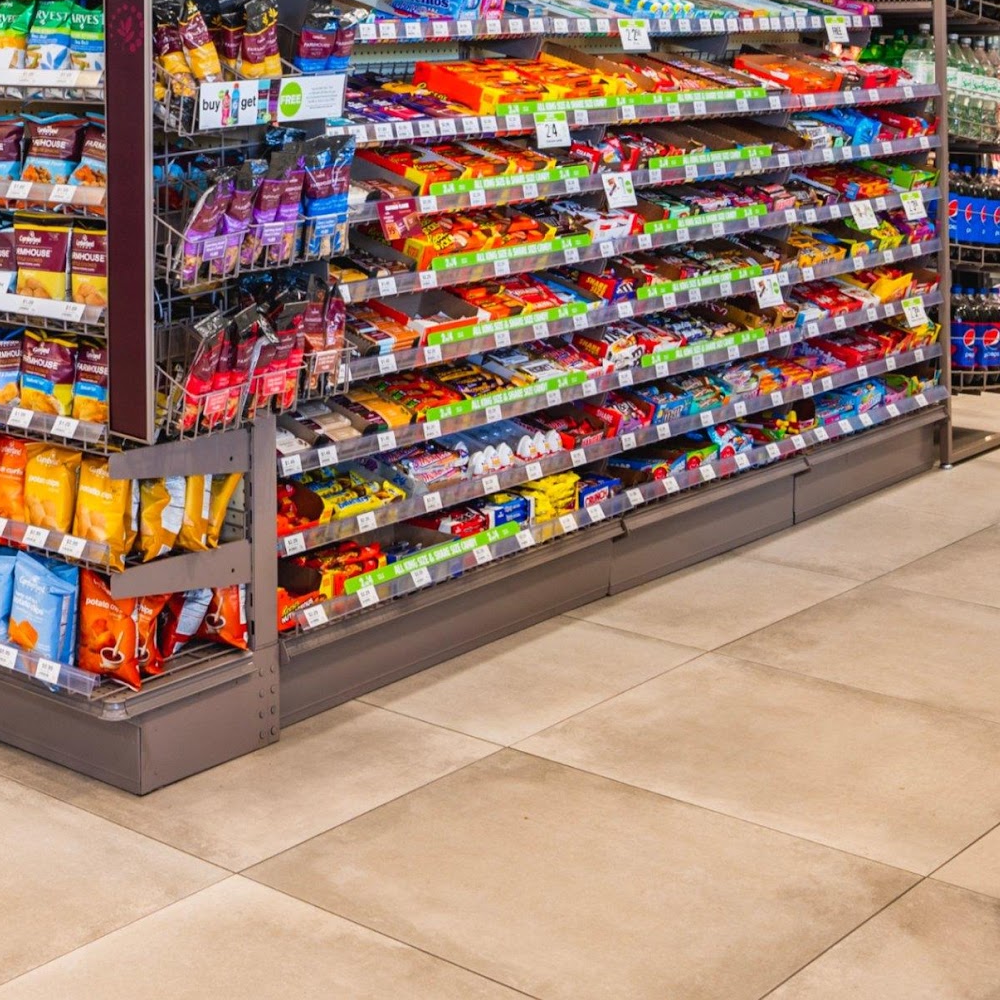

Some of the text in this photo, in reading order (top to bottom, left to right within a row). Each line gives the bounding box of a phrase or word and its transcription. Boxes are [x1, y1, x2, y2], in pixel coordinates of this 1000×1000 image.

[36, 10, 69, 25] RVEST
[71, 13, 101, 29] ARVES
[202, 98, 221, 111] buy
[241, 96, 256, 111] get
[280, 93, 302, 106] FREE
[16, 247, 52, 258] RMHOUSE
[72, 251, 106, 263] RMHOUSE
[86, 597, 110, 609] potato
